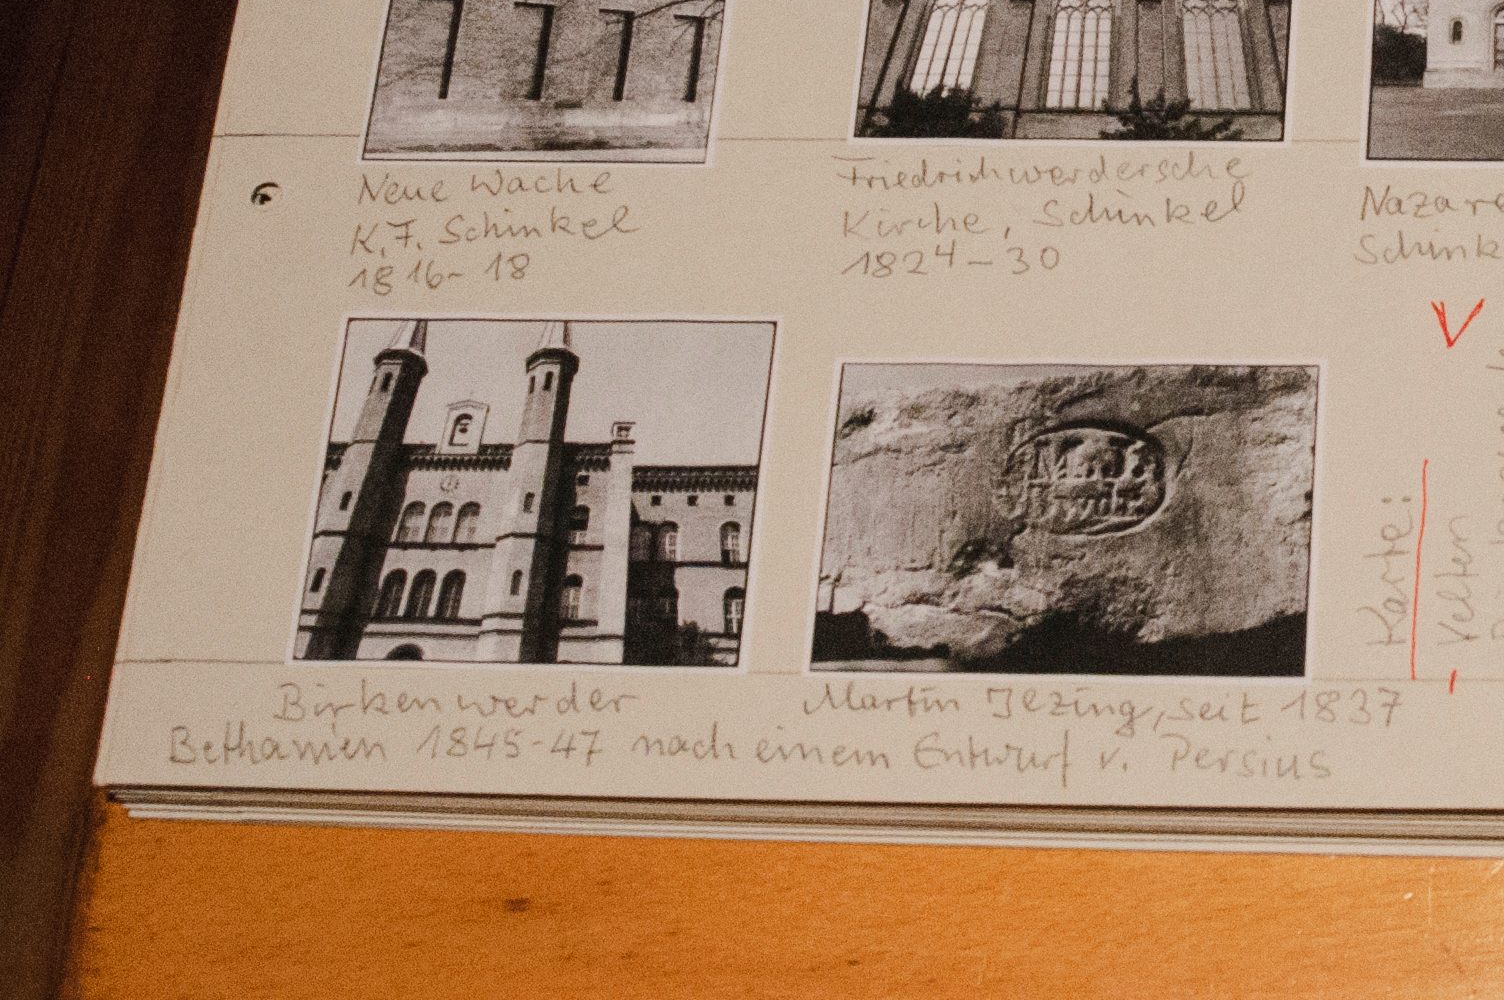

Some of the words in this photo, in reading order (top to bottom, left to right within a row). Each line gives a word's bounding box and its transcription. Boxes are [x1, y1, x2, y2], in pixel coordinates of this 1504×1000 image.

[357, 171, 451, 206] Neue
[1031, 180, 1247, 228] Schinkel
[438, 203, 642, 245] Schinkel
[803, 681, 960, 717] Martin
[1166, 691, 1261, 724] seit
[1280, 687, 1404, 727] 1837
[631, 720, 737, 761] nach
[756, 725, 890, 769] einem
[913, 728, 1070, 789] Entwurf
[1100, 747, 1128, 773] v.
